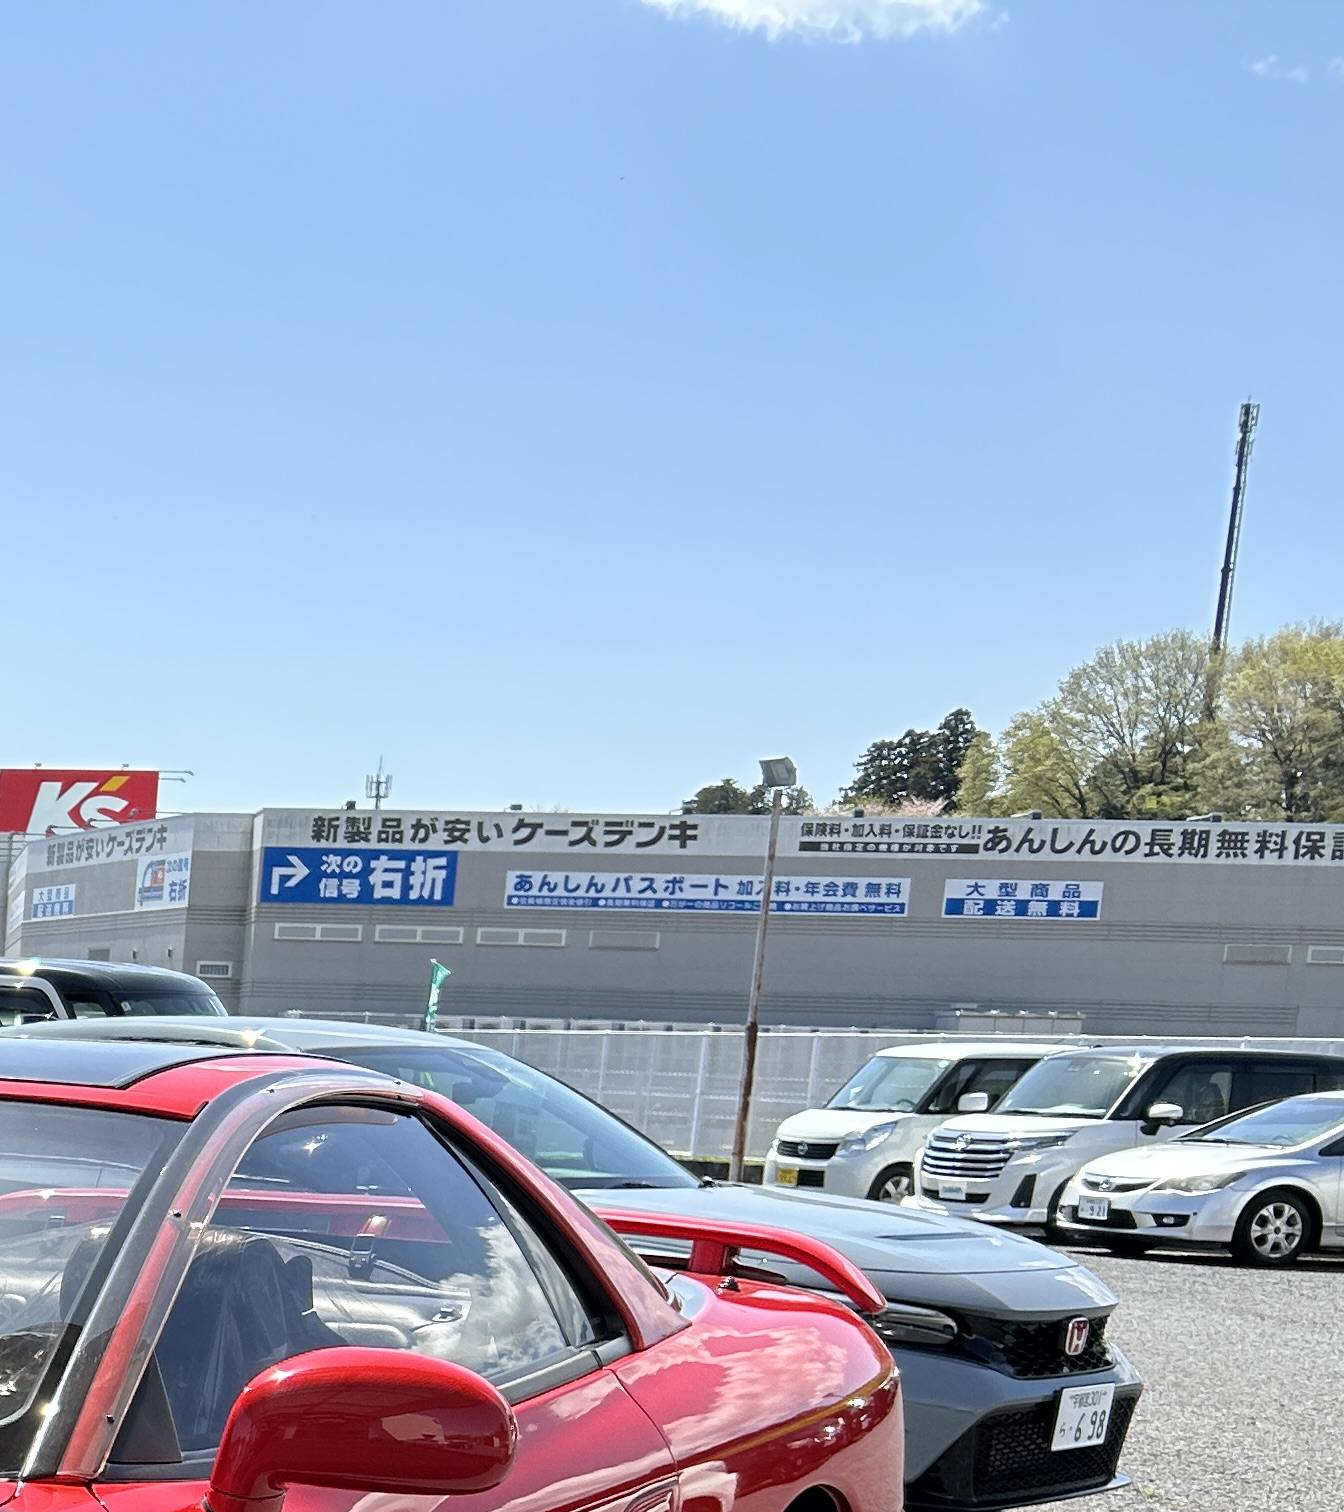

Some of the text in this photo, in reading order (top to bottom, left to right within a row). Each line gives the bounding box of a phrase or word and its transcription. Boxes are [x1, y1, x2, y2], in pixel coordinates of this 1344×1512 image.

[320, 855, 363, 874] 次の
[368, 855, 448, 901] 右折
[319, 877, 362, 899] 信号
[966, 882, 1082, 899] 大型商品
[962, 900, 1081, 918] 配送無料
